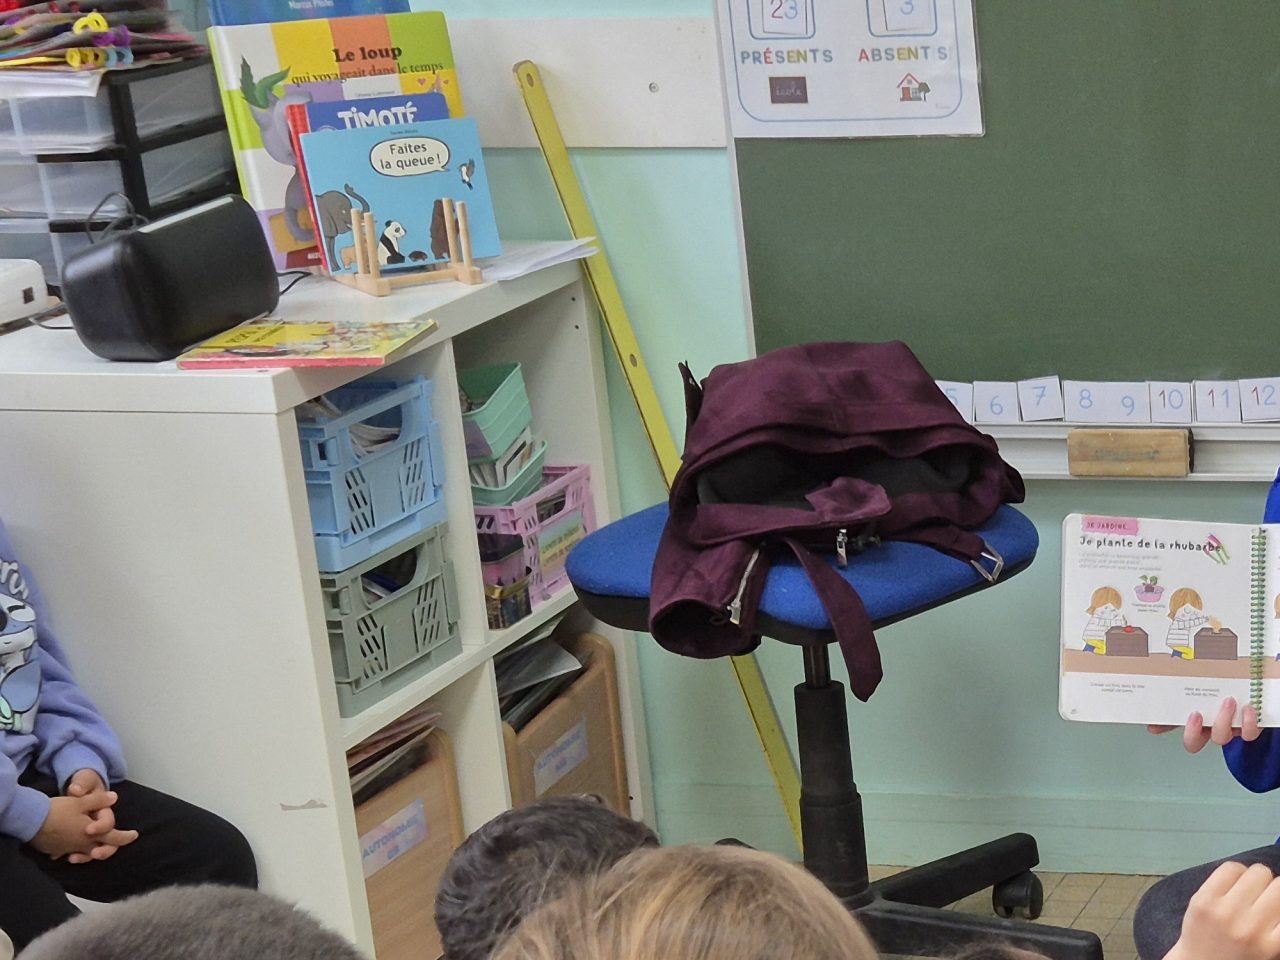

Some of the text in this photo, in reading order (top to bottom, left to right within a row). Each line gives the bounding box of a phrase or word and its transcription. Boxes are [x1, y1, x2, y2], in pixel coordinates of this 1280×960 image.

[333, 46, 402, 63] Le loup
[740, 47, 834, 65] PRÉSENTS
[291, 72, 312, 88] qui
[369, 65, 397, 77] dans
[397, 62, 408, 74] le
[411, 62, 444, 75] temps
[389, 142, 427, 155] Faites
[380, 159, 391, 170] la
[990, 395, 1004, 415] 6
[1032, 386, 1046, 407] 7
[1080, 388, 1092, 409] 8
[1121, 395, 1134, 416] 9
[1158, 389, 1184, 410] 10
[1208, 388, 1230, 408] 11
[1252, 384, 1277, 406] 12
[1080, 536, 1092, 546] Je
[1096, 537, 1133, 549] plante
[1137, 539, 1151, 549] de
[1154, 539, 1165, 549] la
